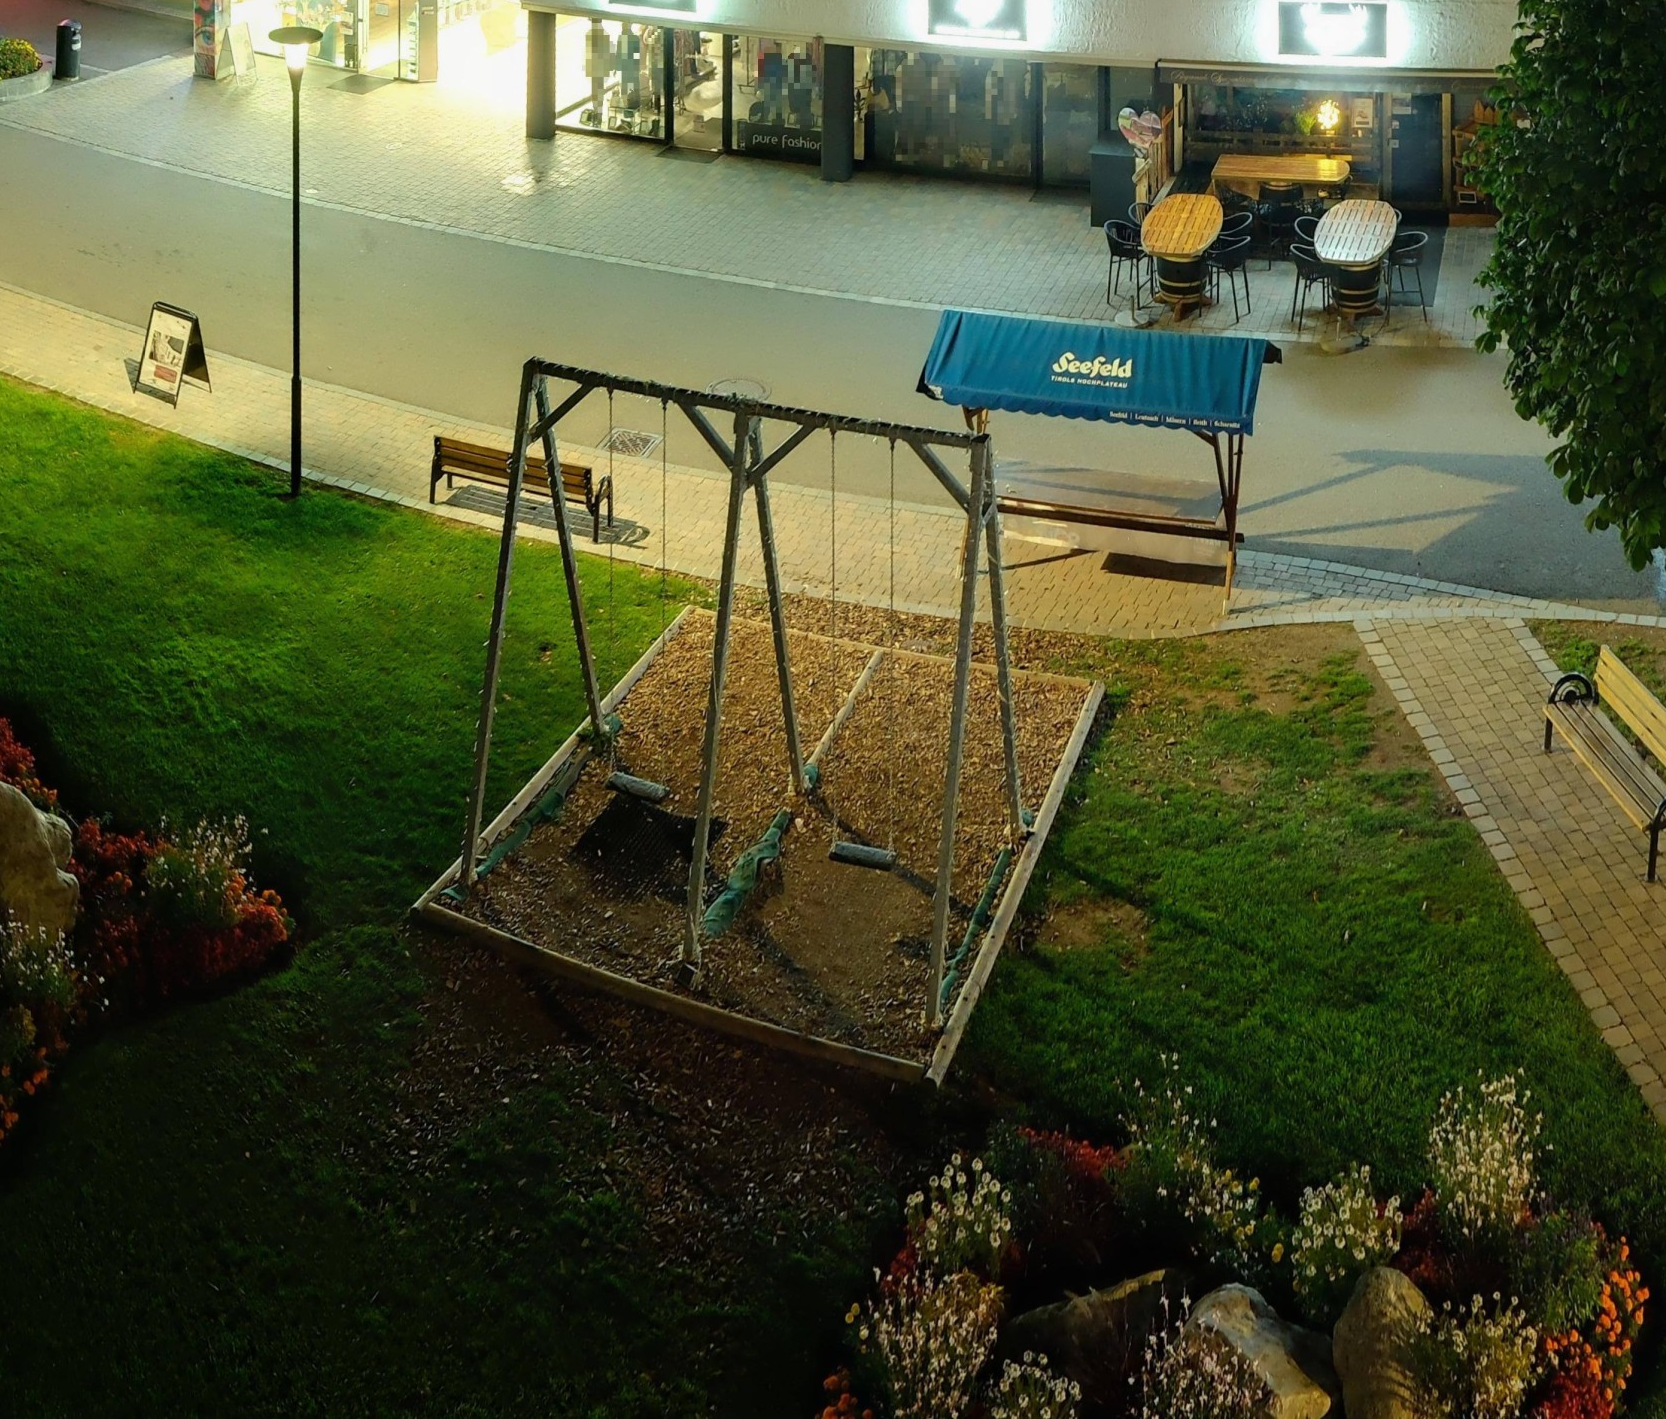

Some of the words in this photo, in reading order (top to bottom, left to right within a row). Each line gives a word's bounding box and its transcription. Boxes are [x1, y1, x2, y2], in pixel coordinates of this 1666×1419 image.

[752, 134, 778, 146] pure
[1052, 351, 1133, 378] Seefeld
[1051, 375, 1075, 383] TIROLS
[1077, 378, 1128, 389] HOCHPLATEAU
